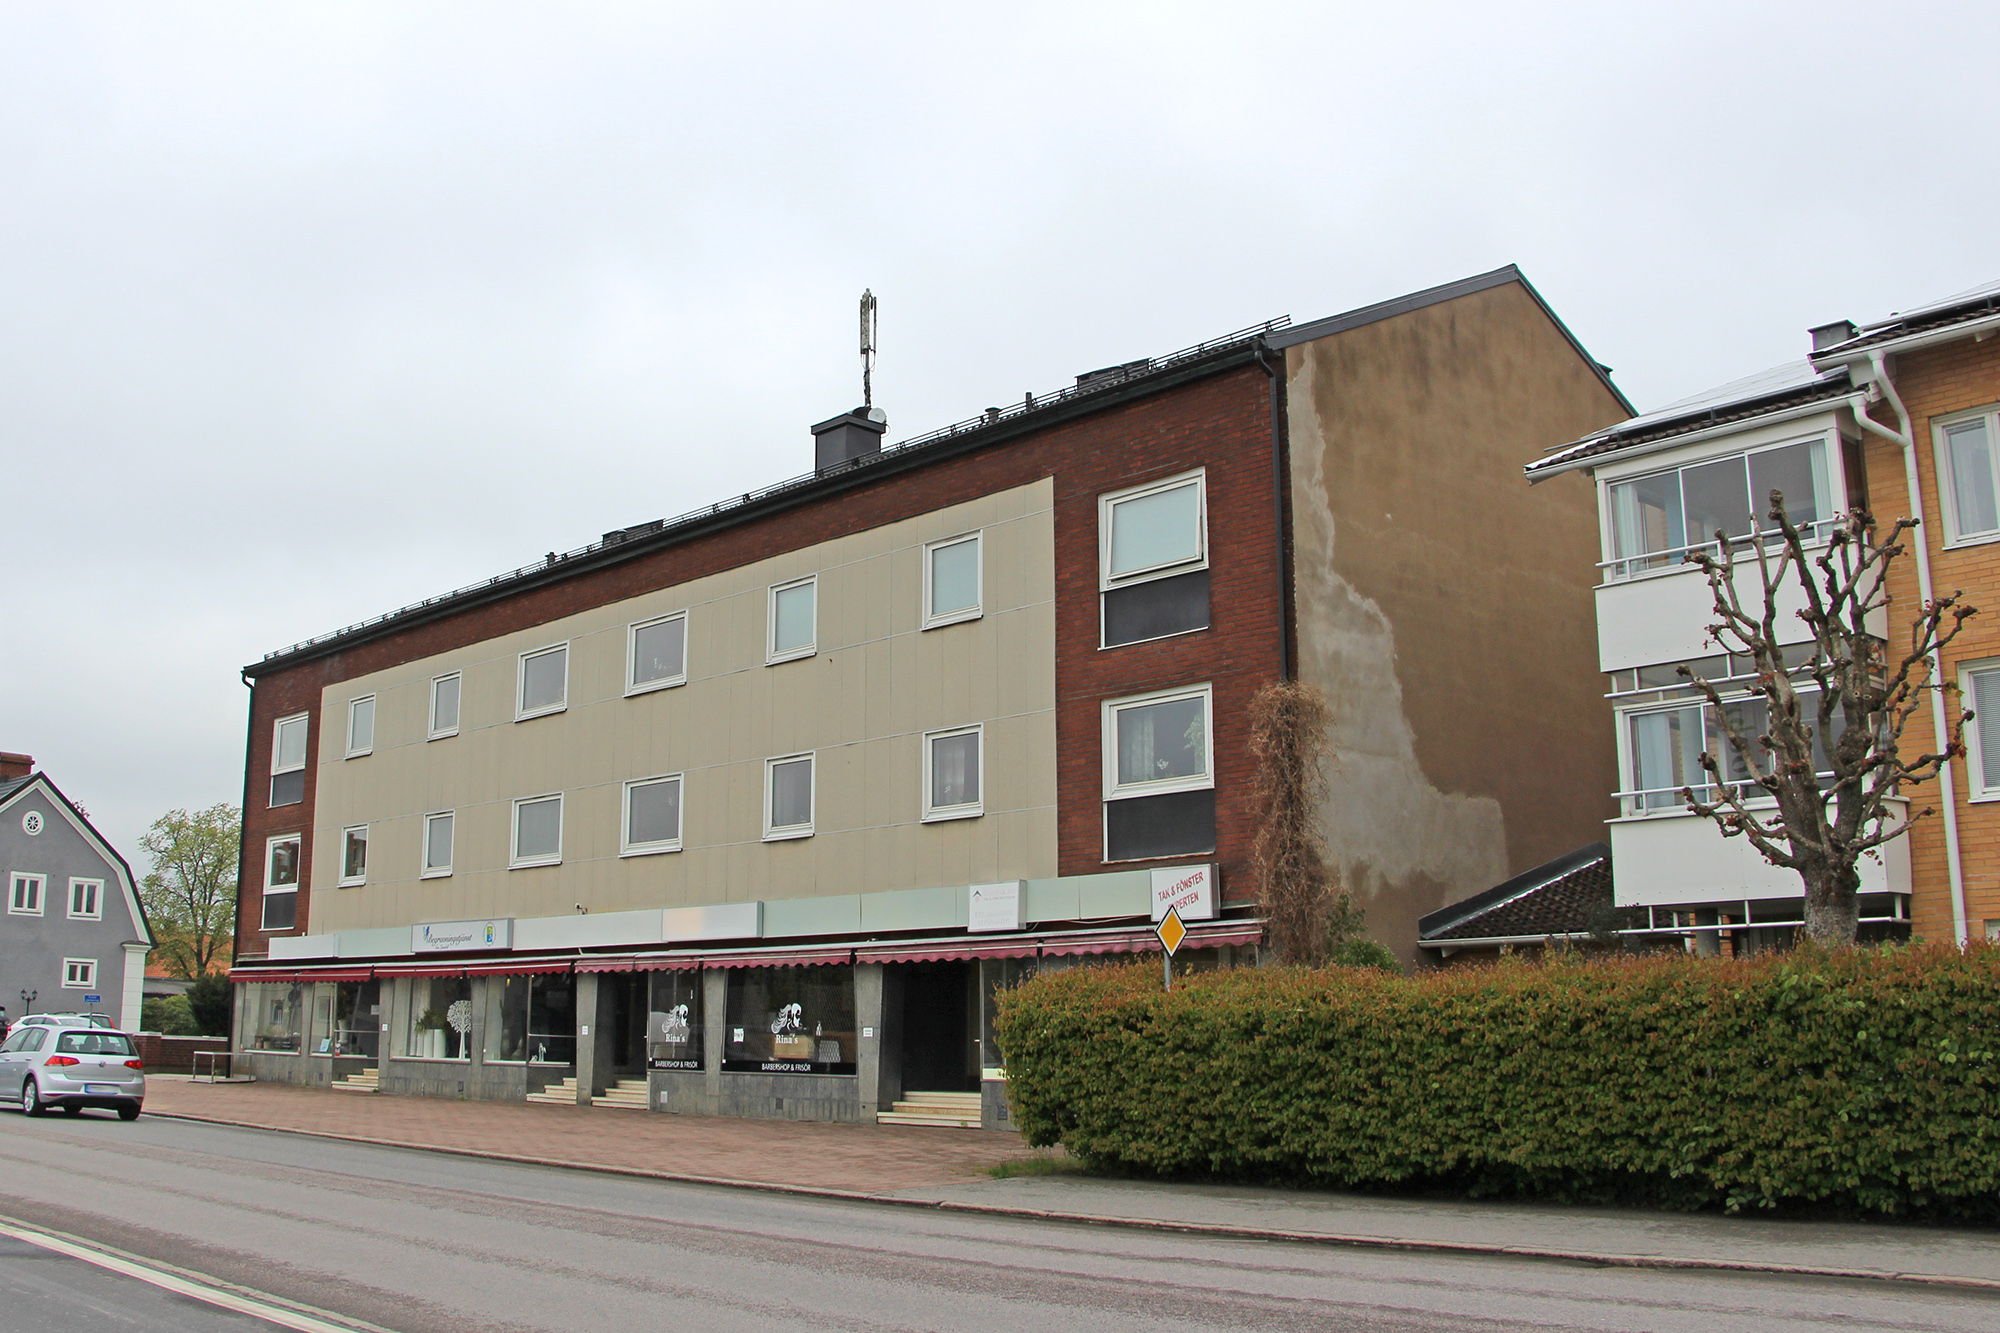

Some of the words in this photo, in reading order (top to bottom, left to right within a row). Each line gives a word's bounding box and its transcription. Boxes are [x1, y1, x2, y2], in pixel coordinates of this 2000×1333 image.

[1158, 889, 1170, 901] TAK
[1171, 886, 1175, 896] &
[1176, 871, 1204, 893] FÖNSTER
[776, 1034, 799, 1044] Rina's
[655, 1060, 679, 1068] BARBERSHOP
[684, 1060, 698, 1068] FRISÖR
[762, 1063, 790, 1071] BARBERSHOP
[795, 1063, 811, 1072] FRISÖR
